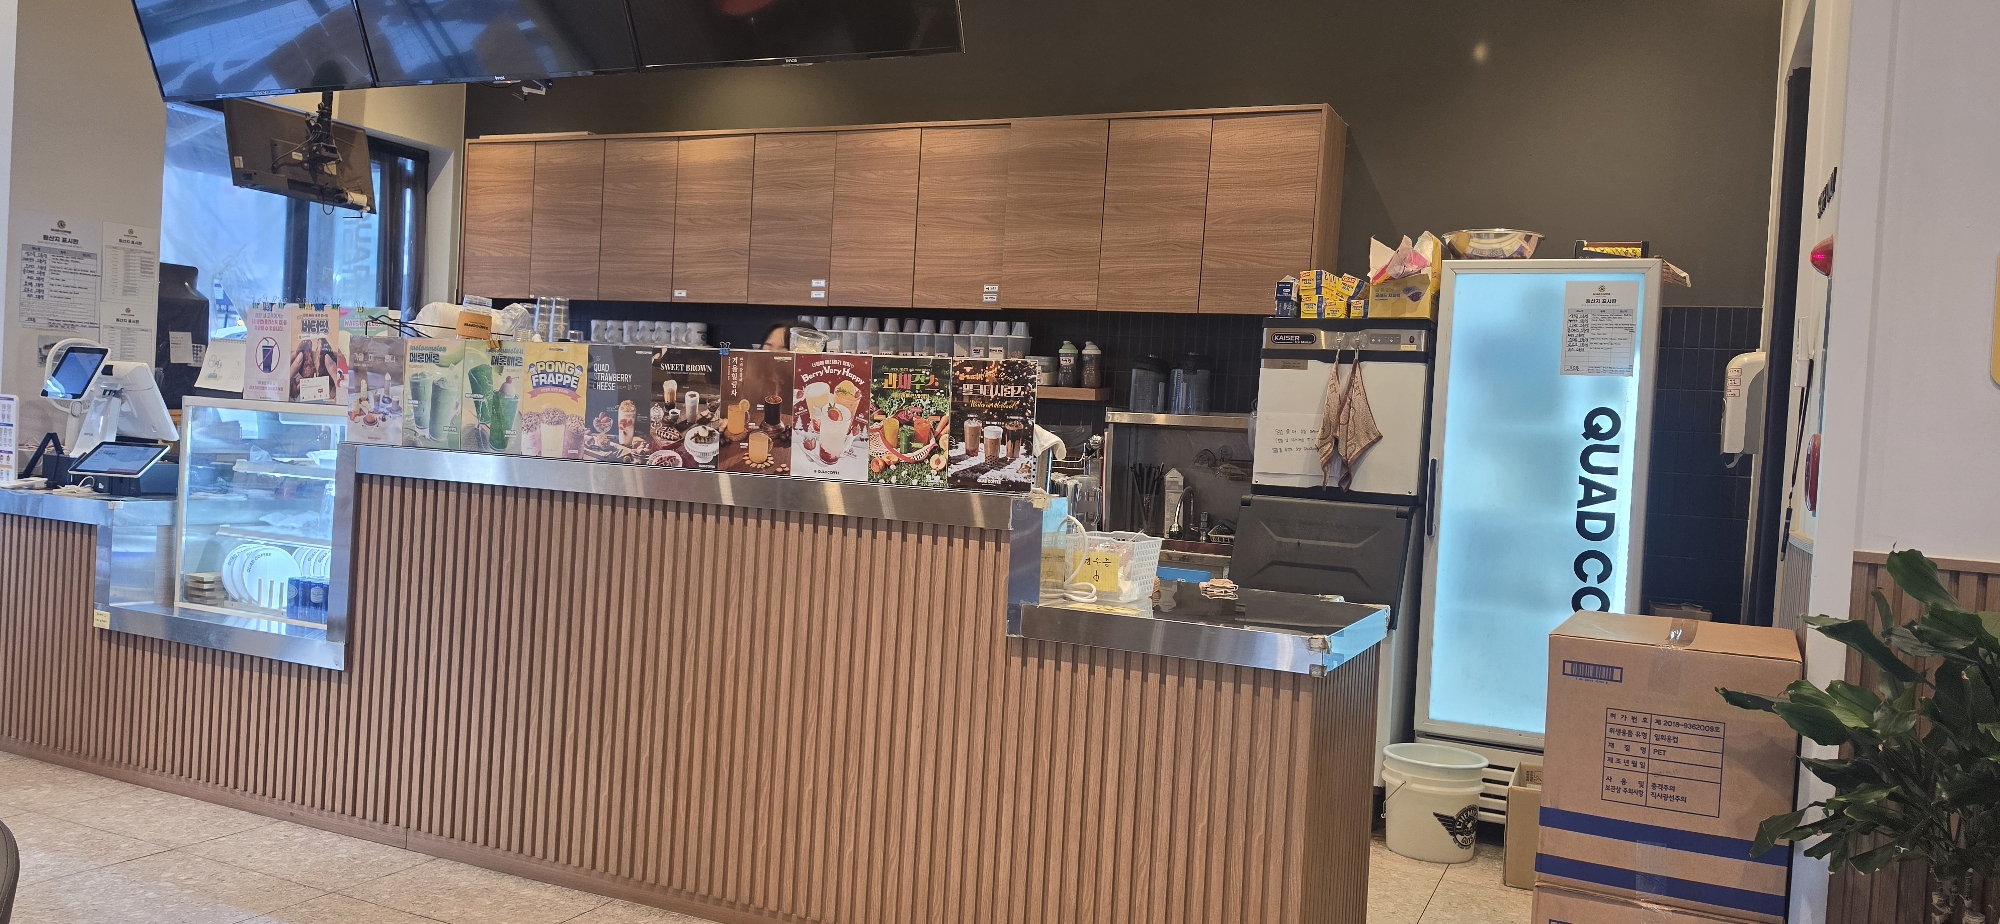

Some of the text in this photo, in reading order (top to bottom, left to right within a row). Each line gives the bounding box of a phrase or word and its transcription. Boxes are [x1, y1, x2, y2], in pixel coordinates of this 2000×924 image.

[536, 361, 576, 375] PONG
[594, 363, 610, 372] QUAD
[660, 362, 712, 372] SWEET BROWN
[531, 372, 580, 388] FRAPPE
[594, 372, 632, 382] STRAWBERRY
[801, 366, 865, 386] Berry Very Happy
[592, 382, 616, 390] CHEESE
[1576, 406, 1622, 542] QUAD
[1655, 718, 1662, 726] 제
[1608, 728, 1648, 740] 위생용품 유형
[1654, 734, 1678, 744] 일회용컵
[1605, 785, 1644, 797] 보관상 주의사항
[1651, 783, 1676, 792] 충격주의
[1650, 792, 1686, 803] 직사광선주의
